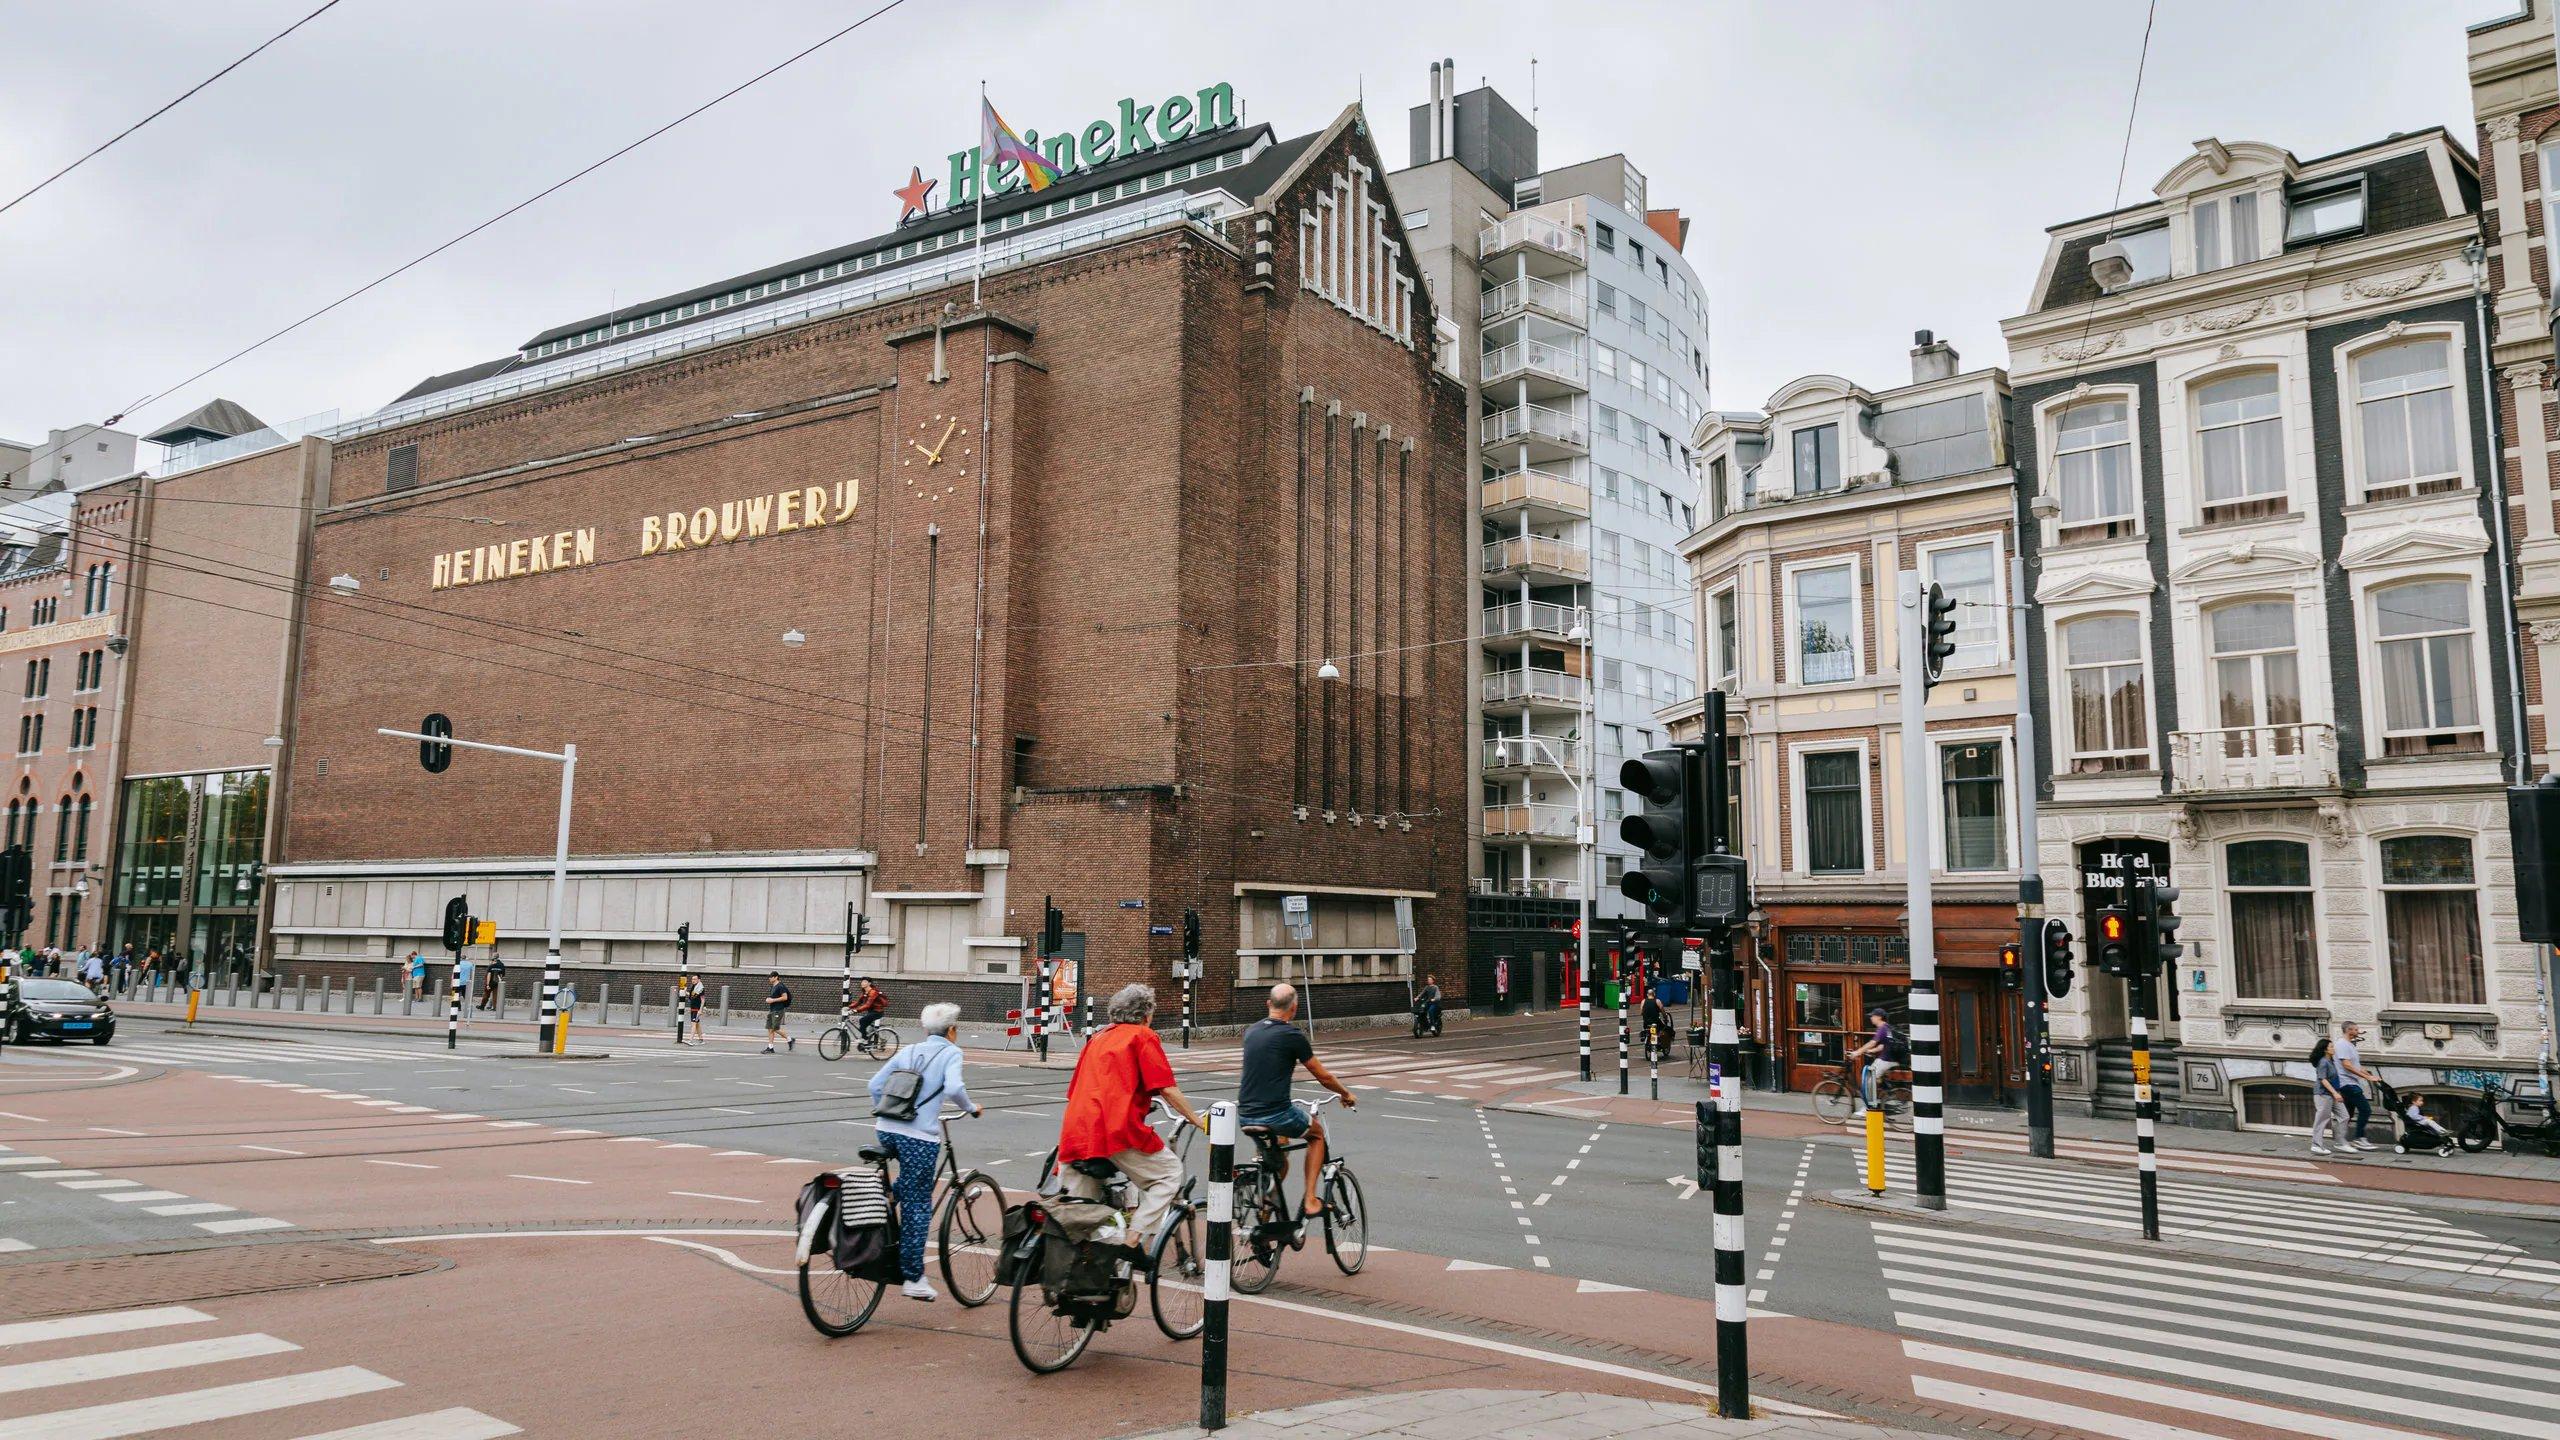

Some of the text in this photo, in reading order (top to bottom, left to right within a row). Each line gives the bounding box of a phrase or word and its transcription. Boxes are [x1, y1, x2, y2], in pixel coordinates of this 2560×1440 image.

[432, 527, 596, 591] HEINEKEN
[2101, 853, 2150, 869] Hoel
[2086, 872, 2168, 888] Bloss
[1657, 916, 1669, 924] 281
[2197, 1073, 2208, 1083] 76
